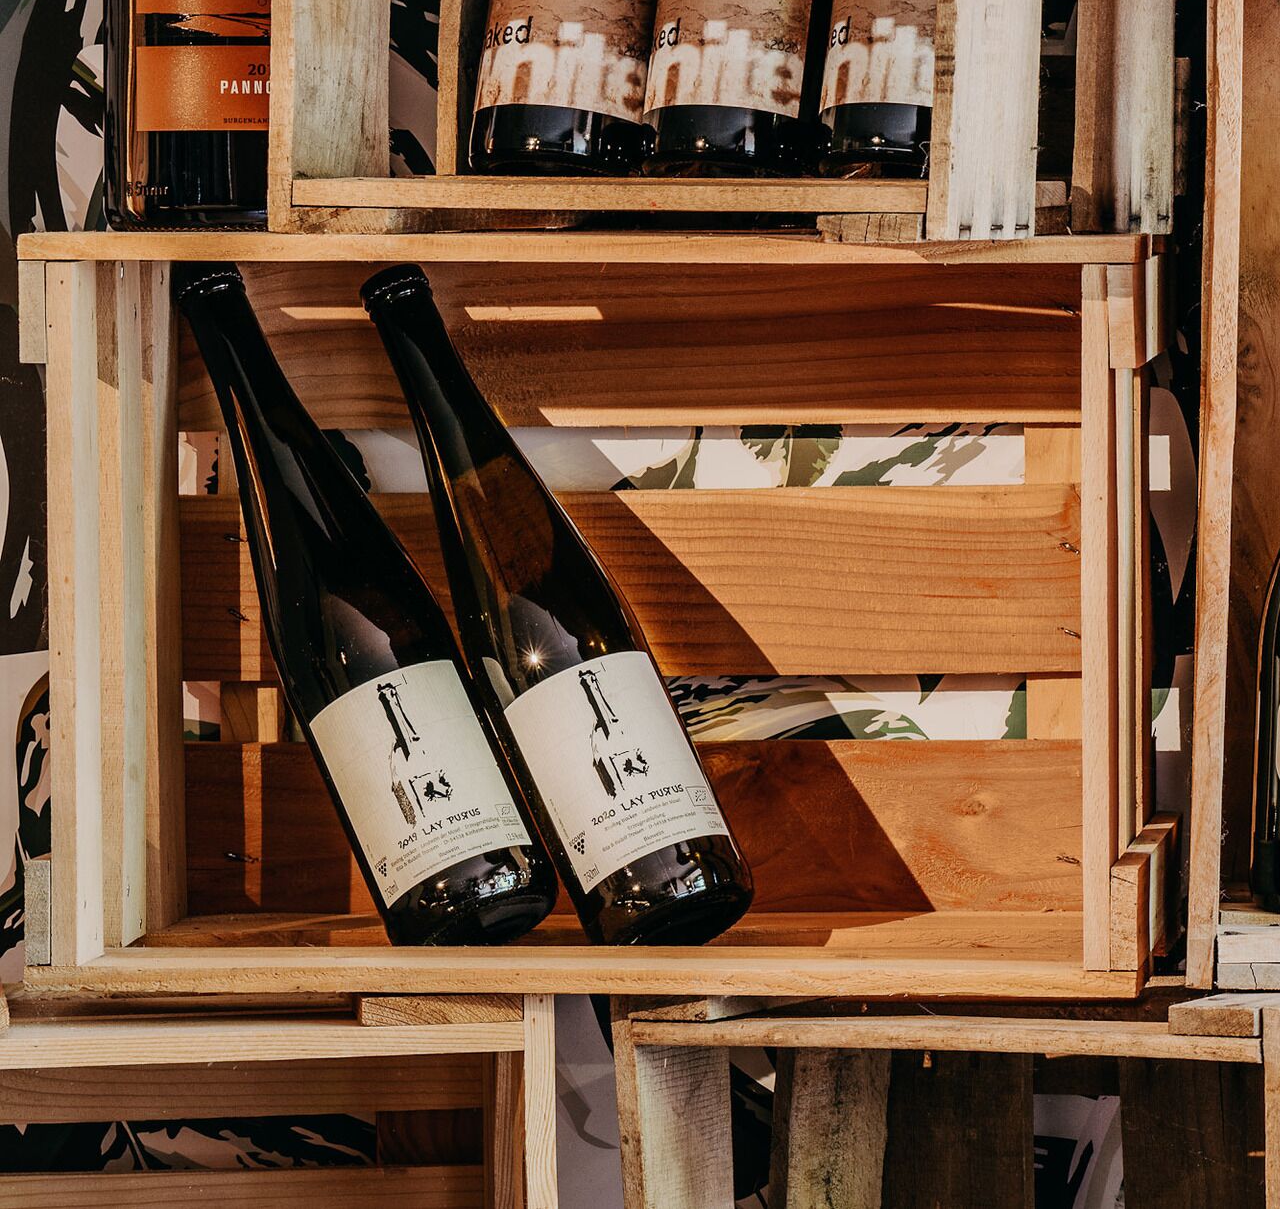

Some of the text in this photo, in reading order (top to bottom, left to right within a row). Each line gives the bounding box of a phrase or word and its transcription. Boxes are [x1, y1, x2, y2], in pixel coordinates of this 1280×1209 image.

[769, 39, 799, 55] 2020
[591, 807, 616, 827] 2020
[621, 794, 645, 812] LAY
[422, 819, 444, 836] LAY
